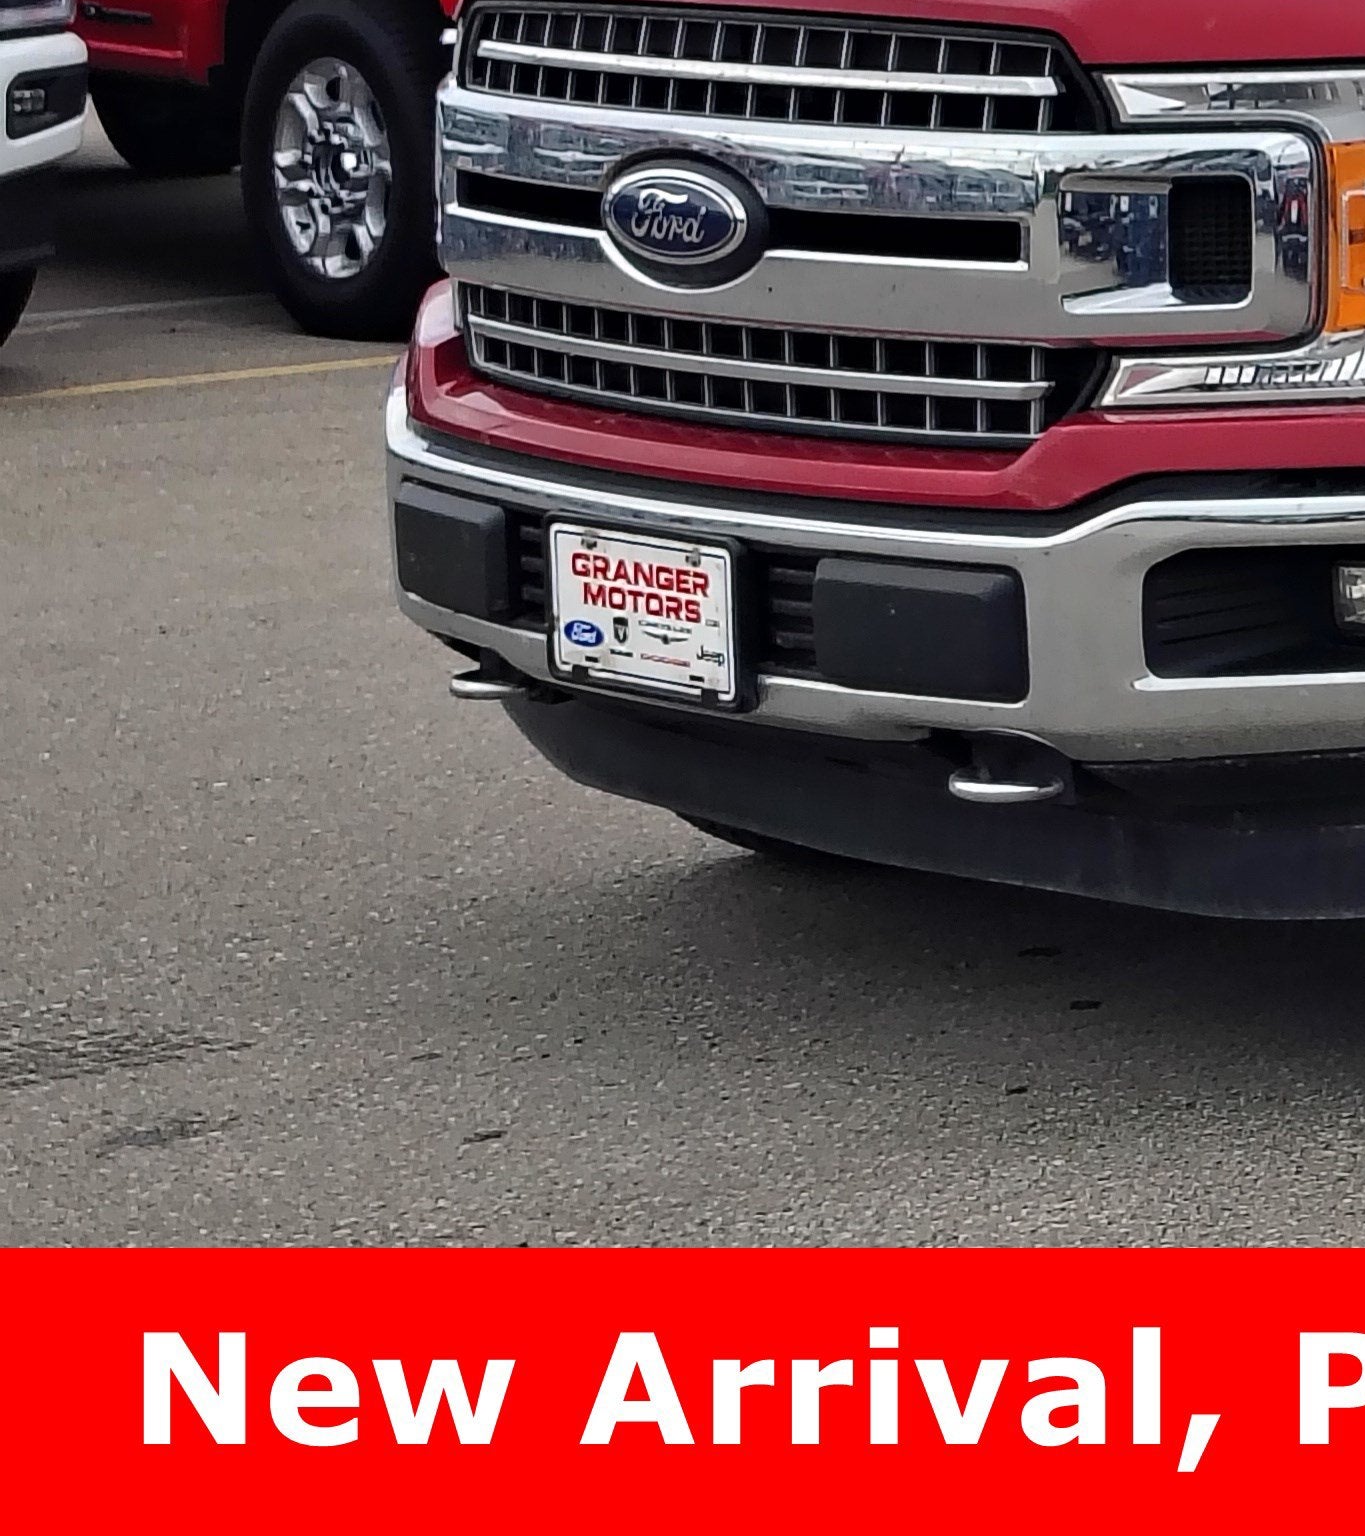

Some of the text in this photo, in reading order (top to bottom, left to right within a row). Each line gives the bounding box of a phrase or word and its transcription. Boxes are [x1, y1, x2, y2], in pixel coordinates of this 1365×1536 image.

[631, 187, 709, 244] Ford
[571, 552, 709, 598] GRANGER
[583, 582, 702, 623] MOTORS
[696, 644, 725, 667] Jeep
